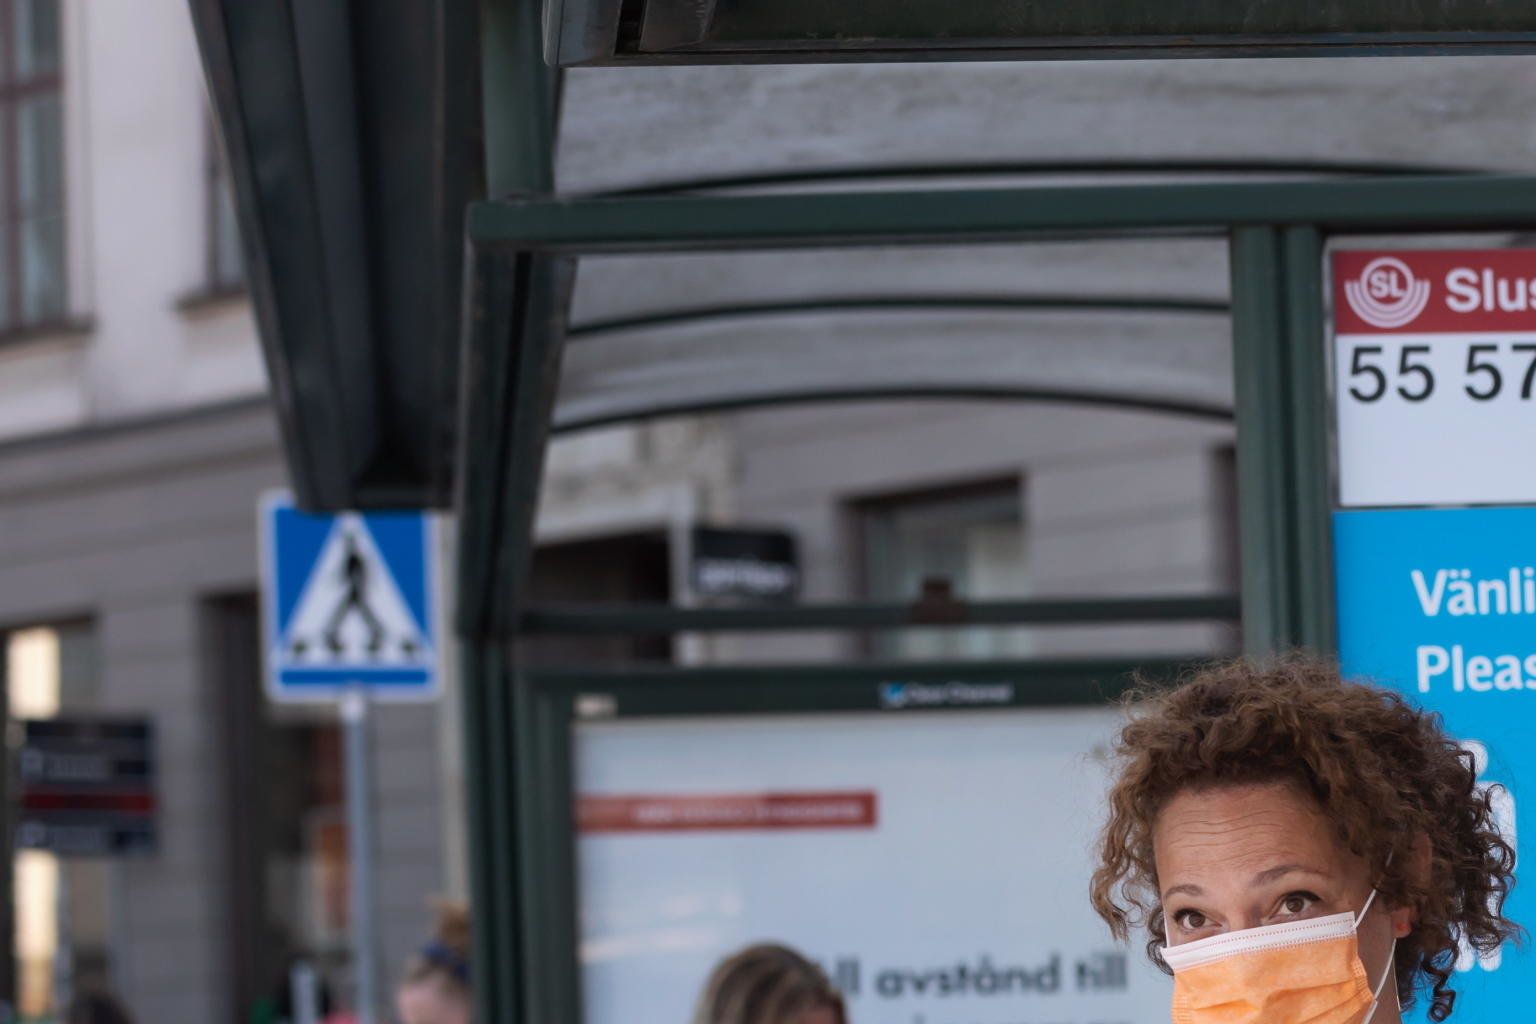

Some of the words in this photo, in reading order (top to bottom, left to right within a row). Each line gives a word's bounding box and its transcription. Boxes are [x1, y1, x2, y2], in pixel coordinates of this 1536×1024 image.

[1370, 270, 1408, 299] SL
[1349, 345, 1435, 403] 55
[874, 953, 1062, 998] avstånd
[1074, 951, 1128, 991] till
